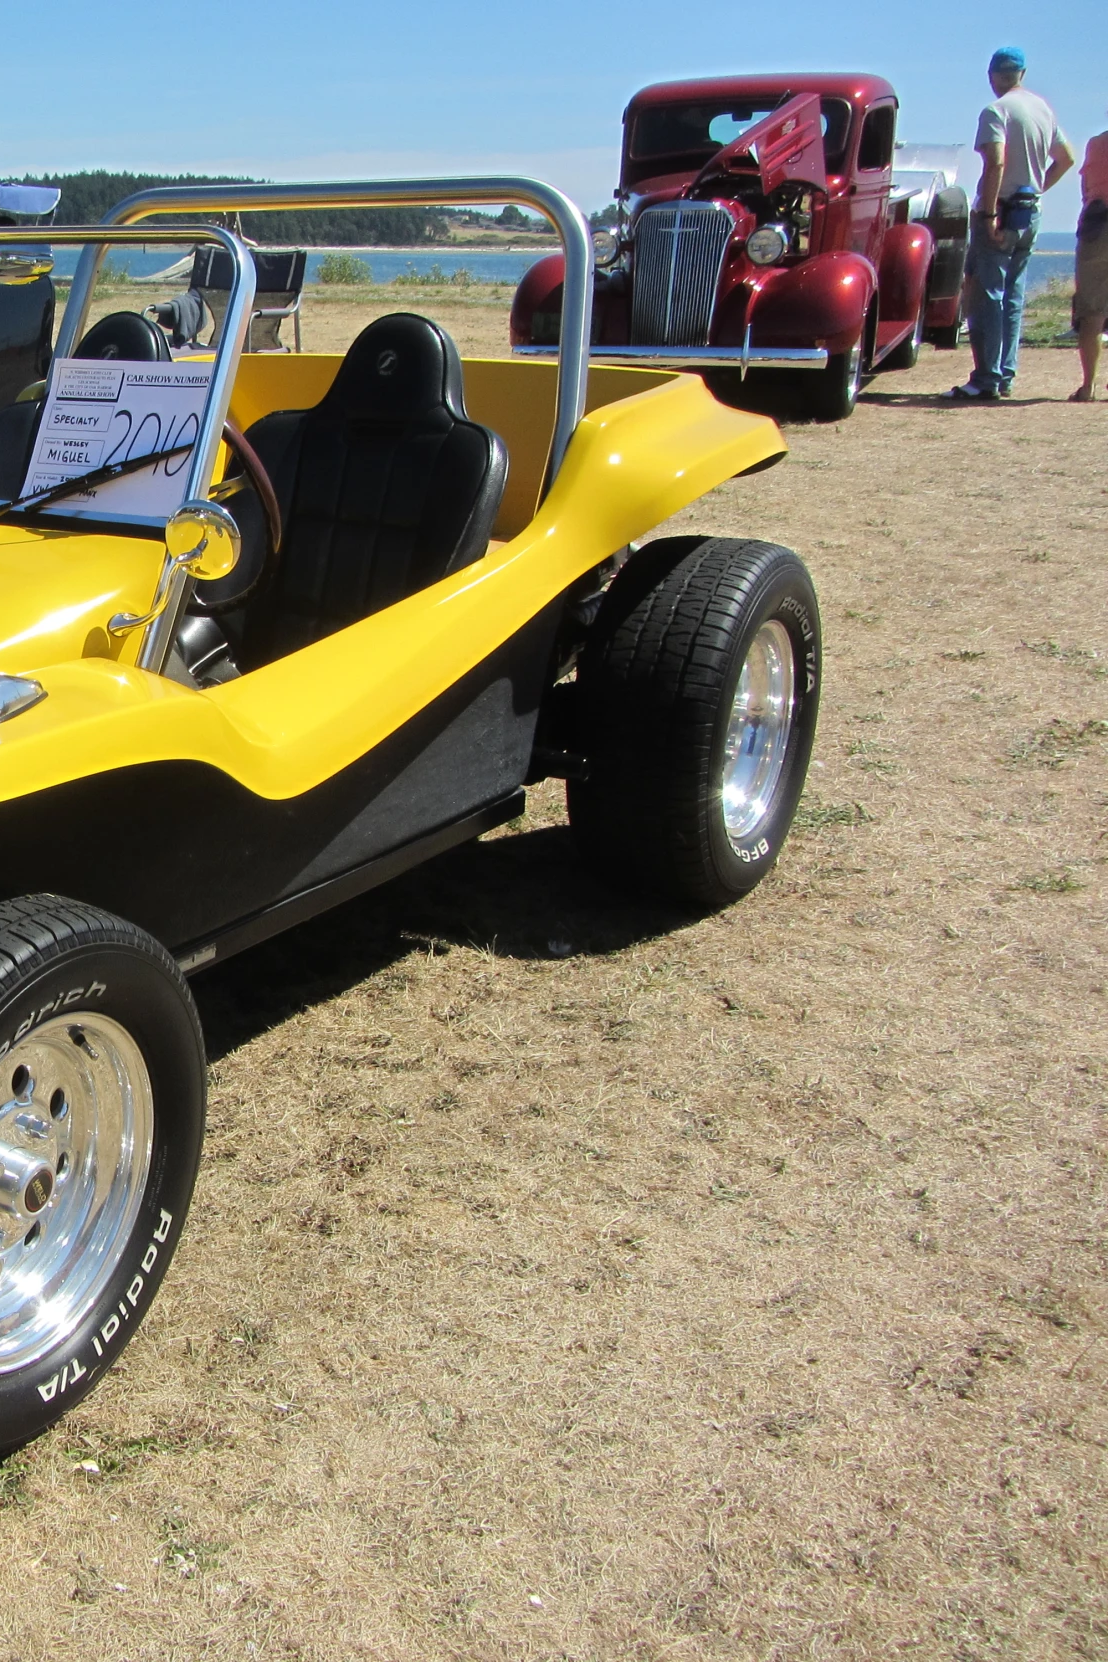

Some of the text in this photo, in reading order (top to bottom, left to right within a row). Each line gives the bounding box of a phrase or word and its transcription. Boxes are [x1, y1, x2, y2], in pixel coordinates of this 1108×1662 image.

[126, 374, 210, 384] CAR SHOW NUMBER
[53, 414, 100, 427] SPECIALTY
[47, 449, 90, 463] MIGUEL
[102, 409, 200, 477] 2010
[778, 596, 816, 693] Radial T/A
[36, 1207, 173, 1403] Radial T/A
